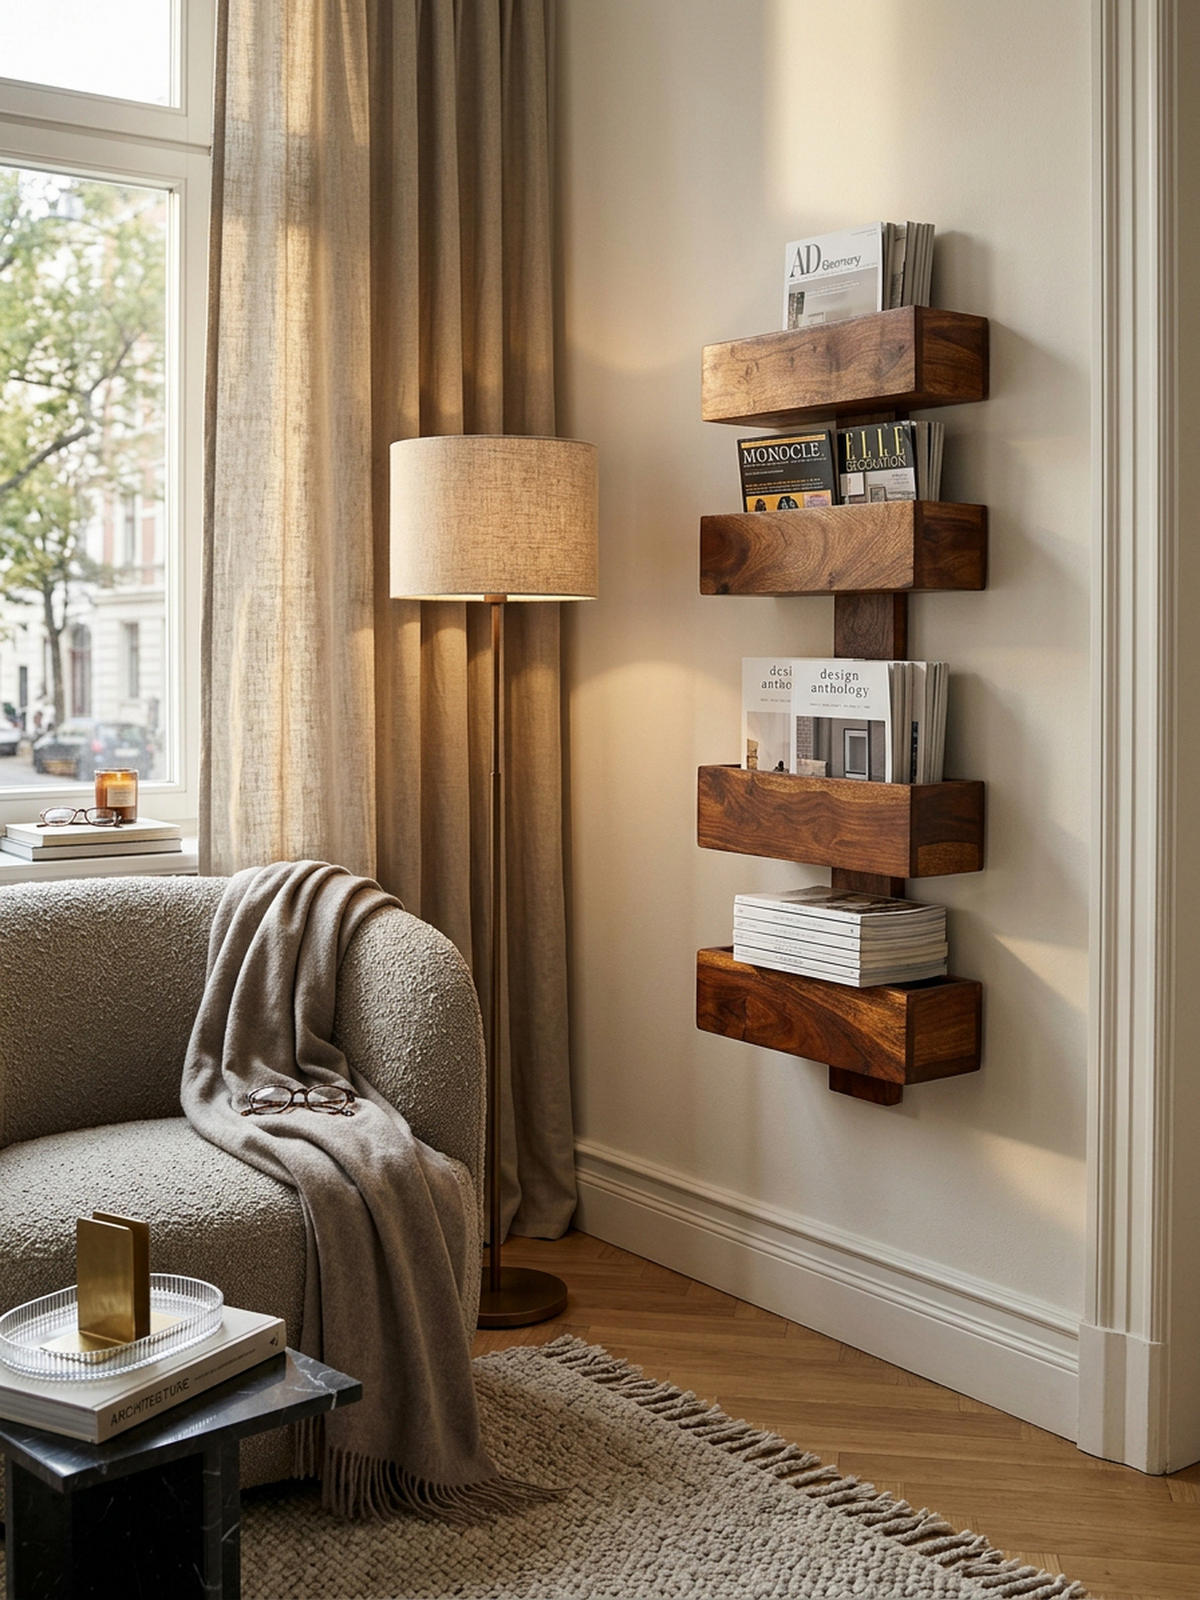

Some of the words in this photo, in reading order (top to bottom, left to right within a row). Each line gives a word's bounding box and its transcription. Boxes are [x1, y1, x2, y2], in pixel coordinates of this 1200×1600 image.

[790, 243, 821, 278] AD
[743, 442, 820, 464] MONOCLE
[769, 665, 792, 676] desi
[820, 668, 859, 683] design
[761, 679, 792, 690] antho
[810, 683, 870, 698] anthology
